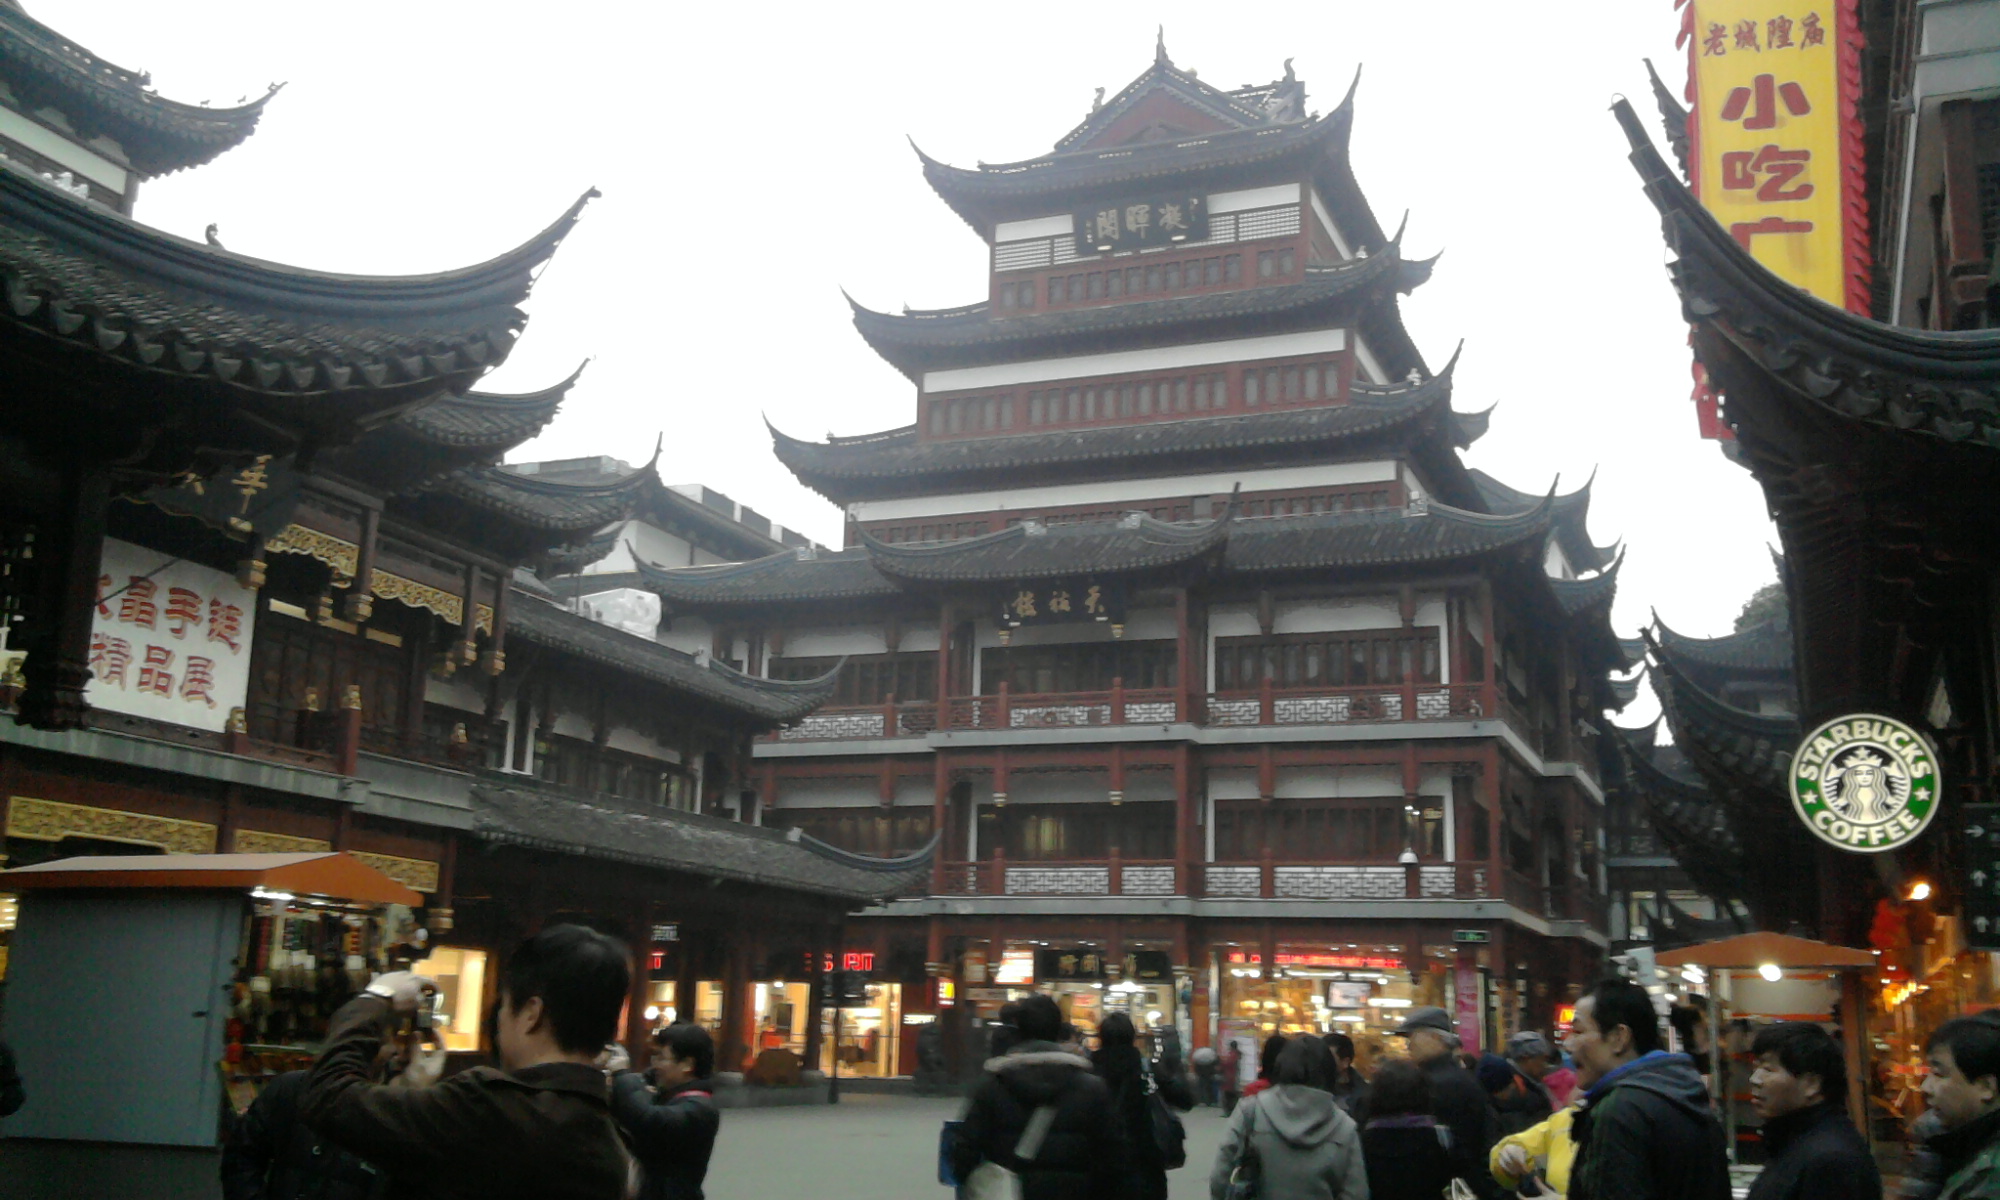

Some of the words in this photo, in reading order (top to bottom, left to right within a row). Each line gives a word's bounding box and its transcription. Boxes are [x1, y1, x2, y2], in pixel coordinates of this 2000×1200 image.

[1702, 12, 1826, 58] 老城隍庙
[1719, 73, 1816, 296] 小吃广
[89, 631, 218, 709] 精品展
[1797, 720, 1933, 781] STARBUCKS
[1813, 809, 1921, 846] COFFEE
